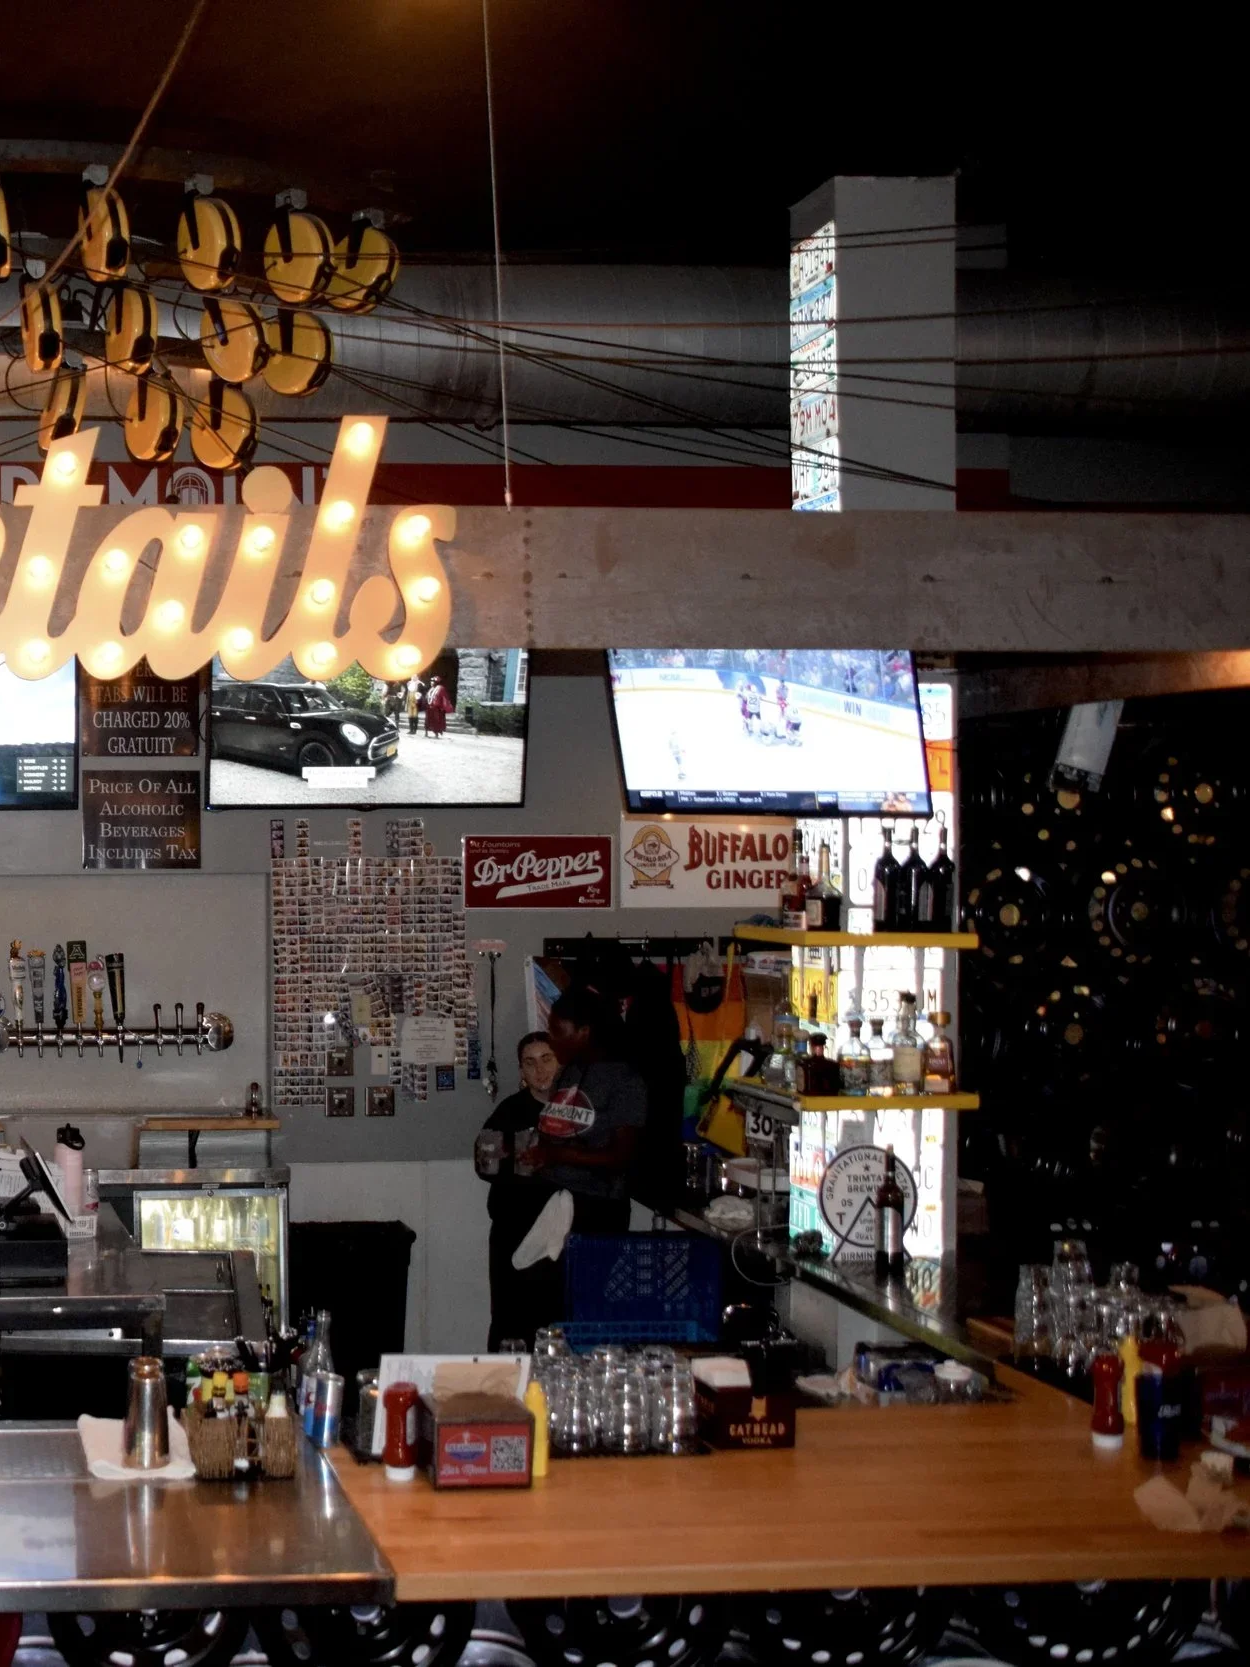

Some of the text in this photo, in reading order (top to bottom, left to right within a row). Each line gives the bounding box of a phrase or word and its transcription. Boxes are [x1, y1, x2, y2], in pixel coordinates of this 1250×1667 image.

[94, 686, 188, 703] TABS WILL BE
[93, 711, 190, 729] CHARGED 20%
[107, 736, 176, 754] GRATUITY
[684, 824, 789, 871] BUFFALO
[472, 849, 602, 887] Dr Pepper
[750, 1113, 773, 1136] 30
[826, 1152, 885, 1200] GRAVITATIONAL
[847, 1174, 884, 1183] TRIMTA
[847, 1184, 879, 1194] BREWI
[840, 1251, 875, 1261] BIRMIN
[729, 1423, 786, 1436] CATHEAD
